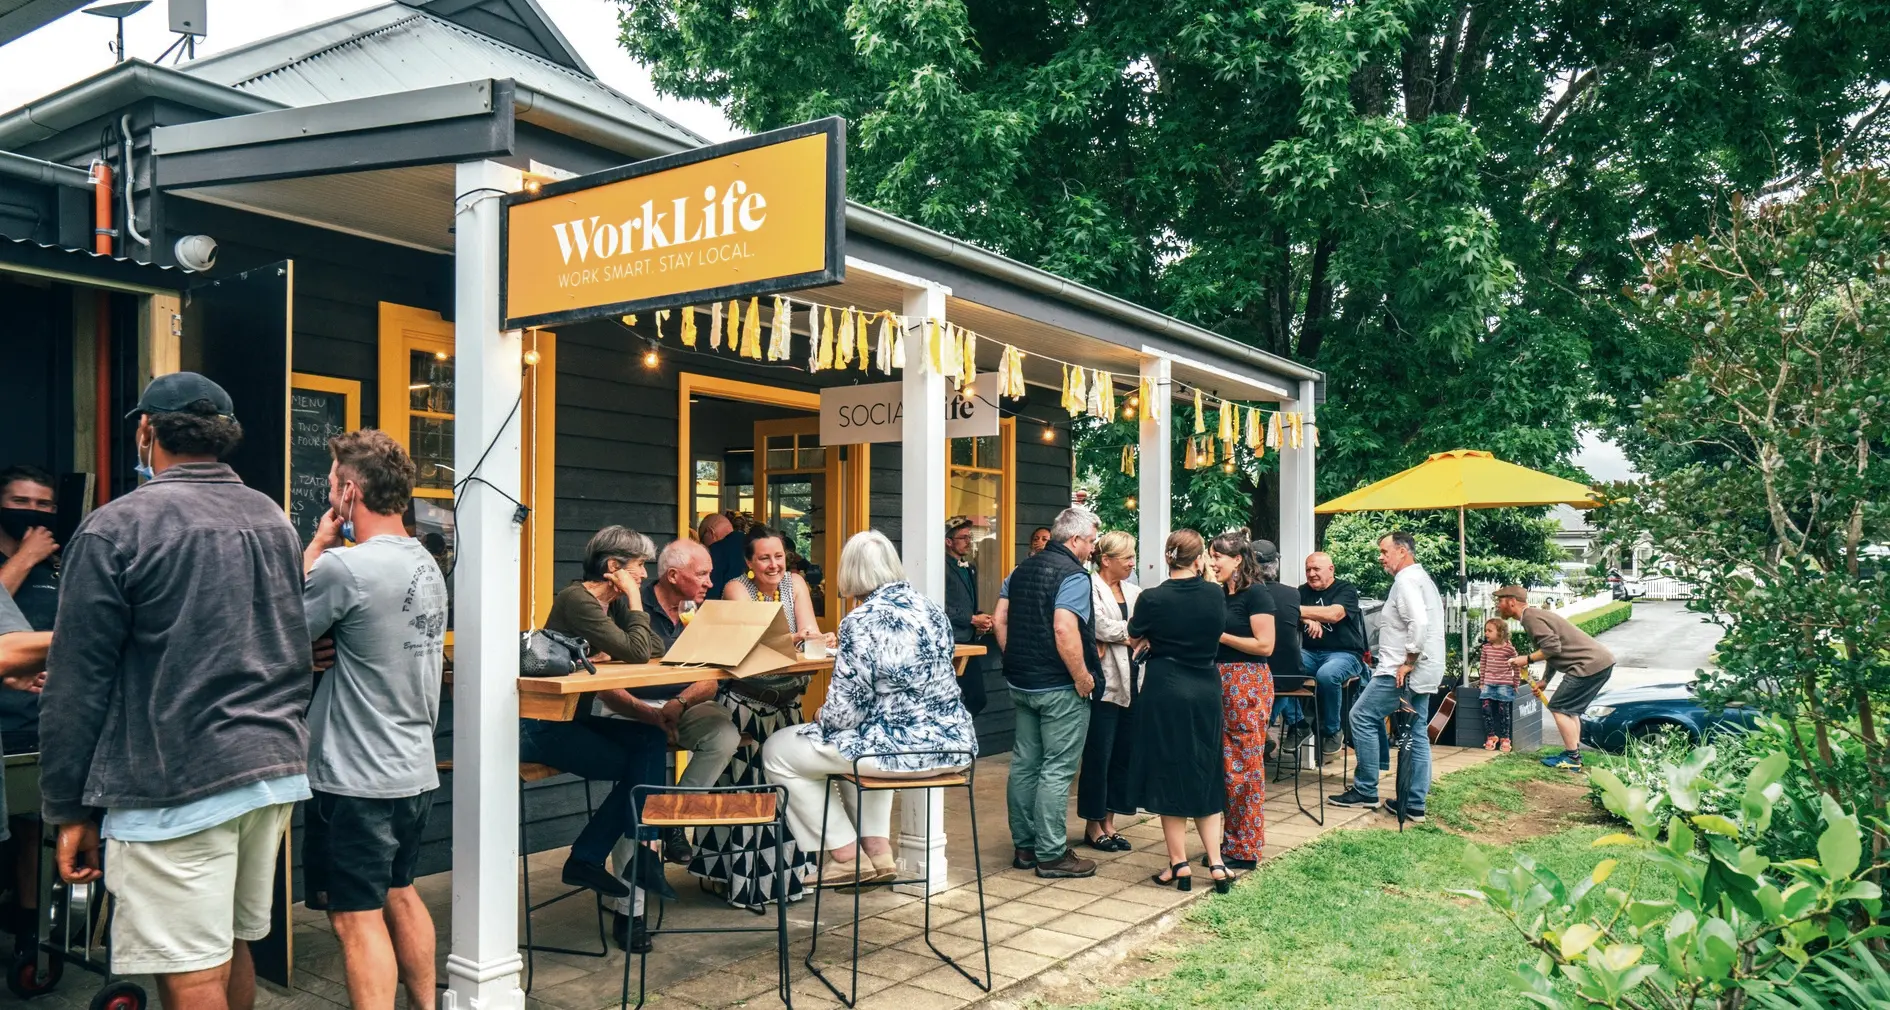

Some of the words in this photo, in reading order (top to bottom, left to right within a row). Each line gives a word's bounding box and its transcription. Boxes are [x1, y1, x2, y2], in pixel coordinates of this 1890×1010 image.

[552, 180, 767, 266] WorkLife
[559, 268, 599, 288] WORK
[603, 258, 654, 282] SMART.
[659, 252, 694, 273] STAY
[699, 242, 755, 266] LOCAL.
[839, 401, 904, 427] SOCIA
